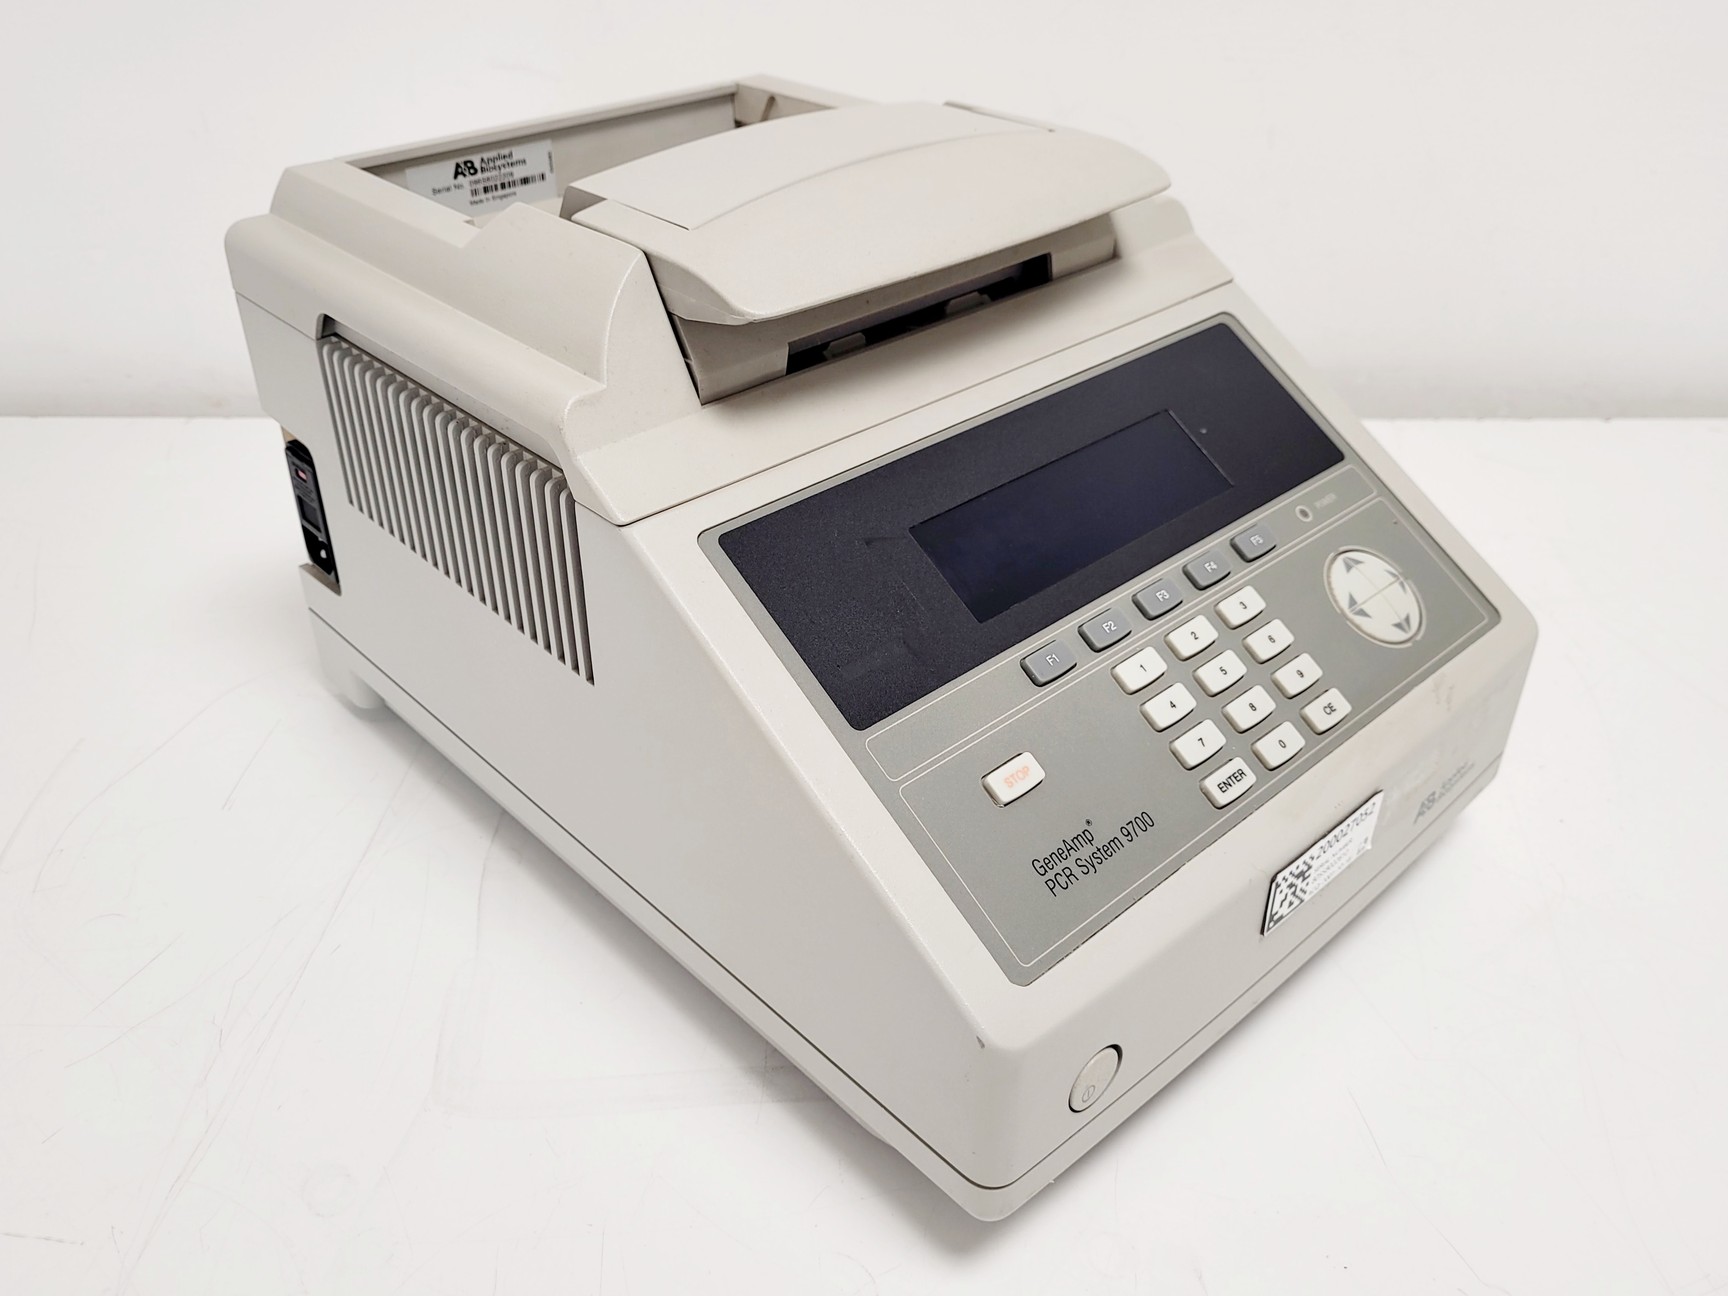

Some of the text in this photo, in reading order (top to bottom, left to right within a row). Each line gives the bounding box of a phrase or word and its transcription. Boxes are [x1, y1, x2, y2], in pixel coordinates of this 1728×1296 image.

[481, 151, 513, 165] Applied
[481, 159, 526, 174] Biosystems
[1250, 534, 1264, 546] F5
[1204, 560, 1218, 573] F4
[1155, 589, 1170, 602] F3
[1239, 600, 1248, 610] 3
[1102, 620, 1117, 634] F2
[1190, 630, 1199, 641] 2
[1267, 634, 1276, 644] 6
[1045, 653, 1060, 667] F1
[1139, 663, 1147, 673] 1
[1219, 665, 1228, 676] 5
[1296, 669, 1304, 679] 9
[1169, 700, 1177, 710] 4
[1248, 702, 1257, 712] 8
[1322, 702, 1337, 716] CE
[1198, 737, 1207, 748] 7
[1278, 739, 1287, 749] 0
[1004, 766, 1029, 788] STOP
[1217, 768, 1247, 794] ENTER
[1044, 811, 1155, 897] PCR System 9700
